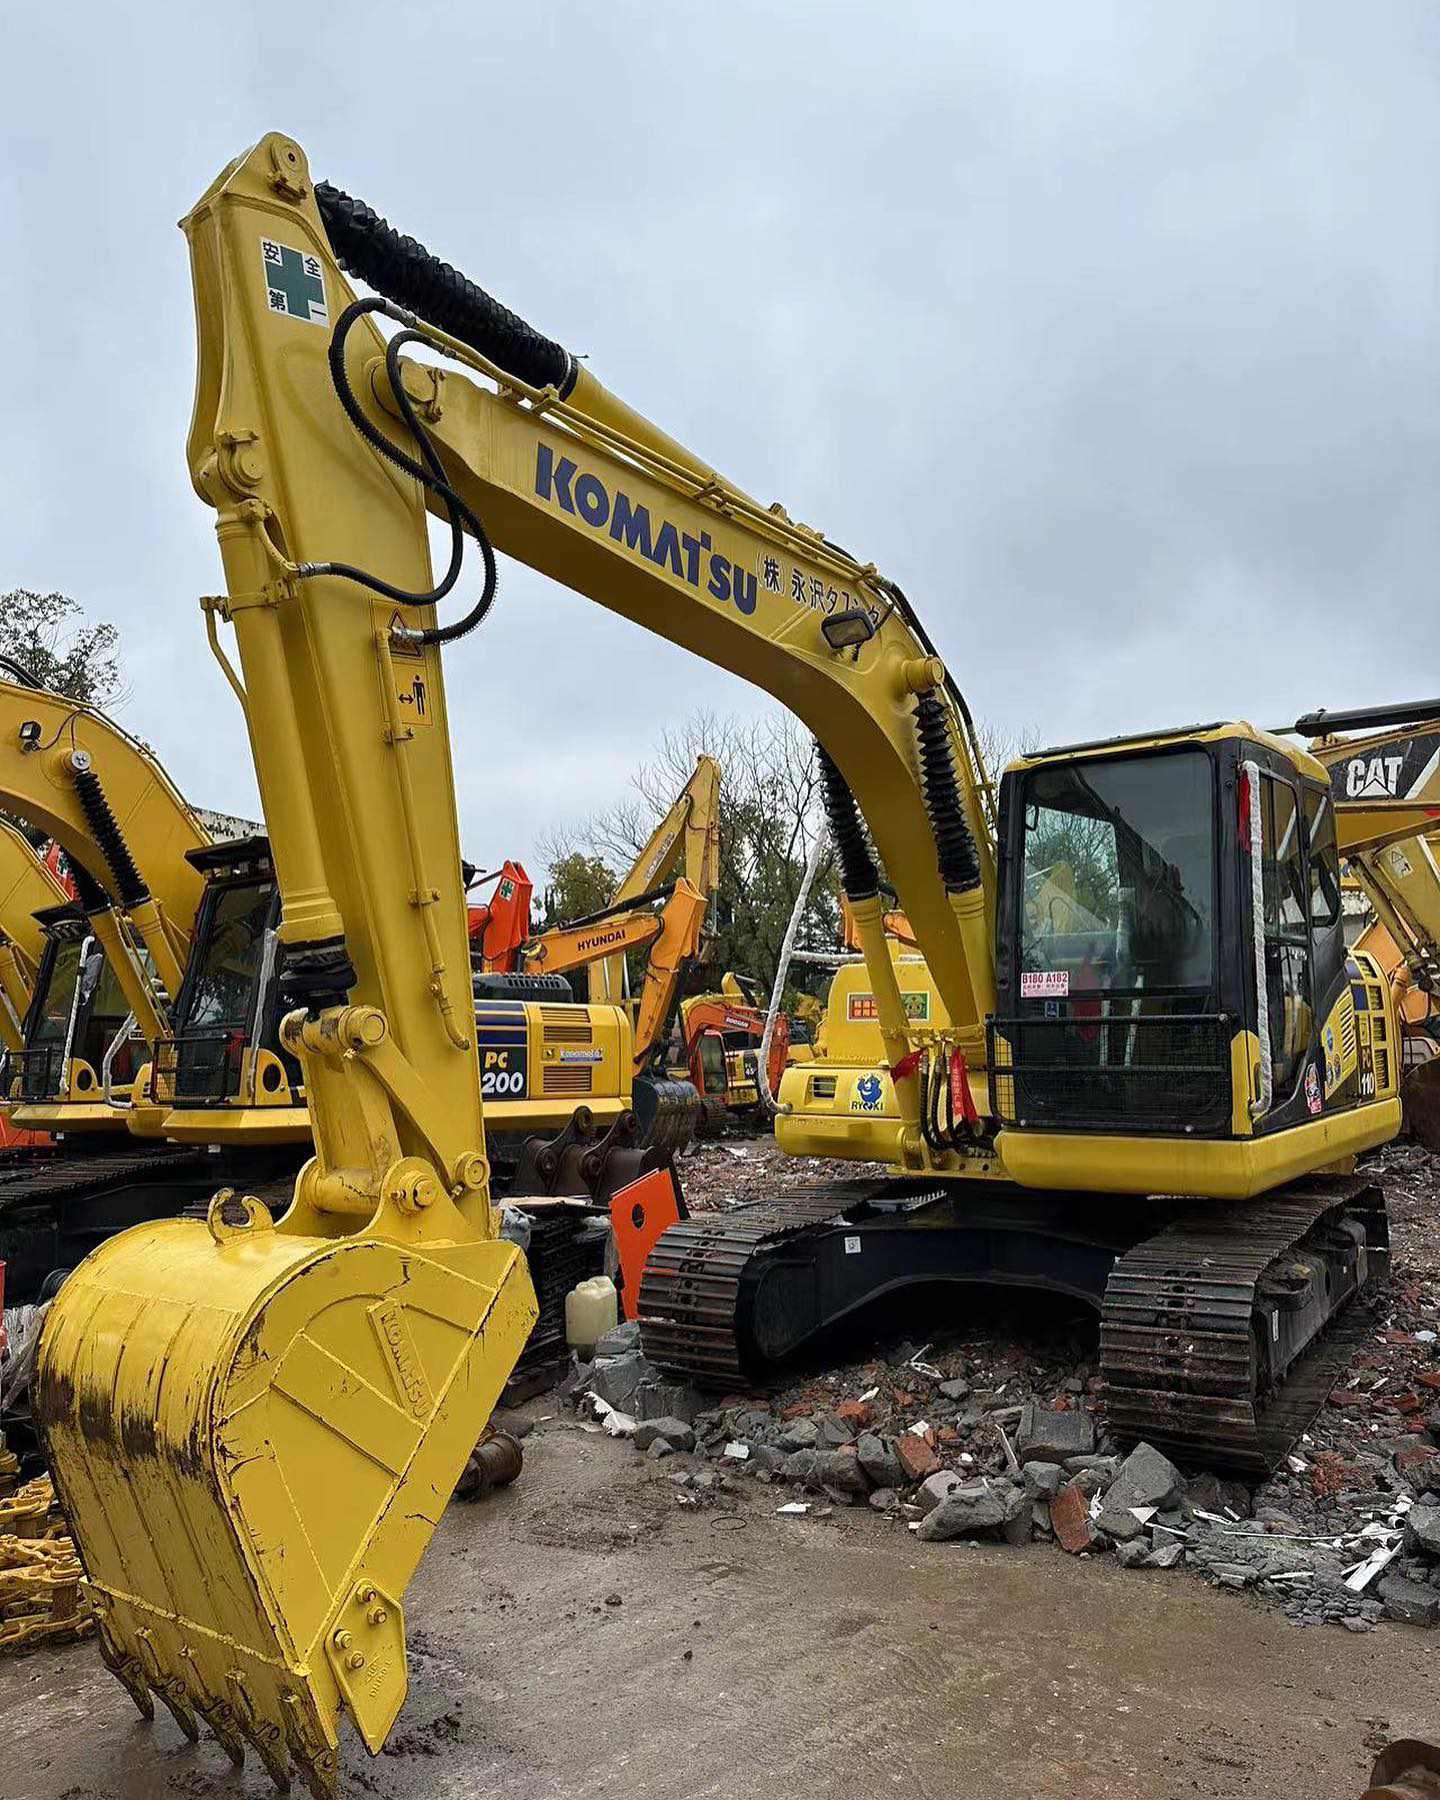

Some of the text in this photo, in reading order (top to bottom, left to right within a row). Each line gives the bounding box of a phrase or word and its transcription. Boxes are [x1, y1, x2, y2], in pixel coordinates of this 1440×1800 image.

[263, 241, 321, 277] 安 全
[535, 441, 758, 616] KOMATSU
[1346, 756, 1404, 798] CAT
[577, 929, 626, 951] HYUNDAI
[484, 1051, 509, 1069] PC
[481, 1071, 525, 1094] 200
[1361, 1071, 1375, 1096] 110
